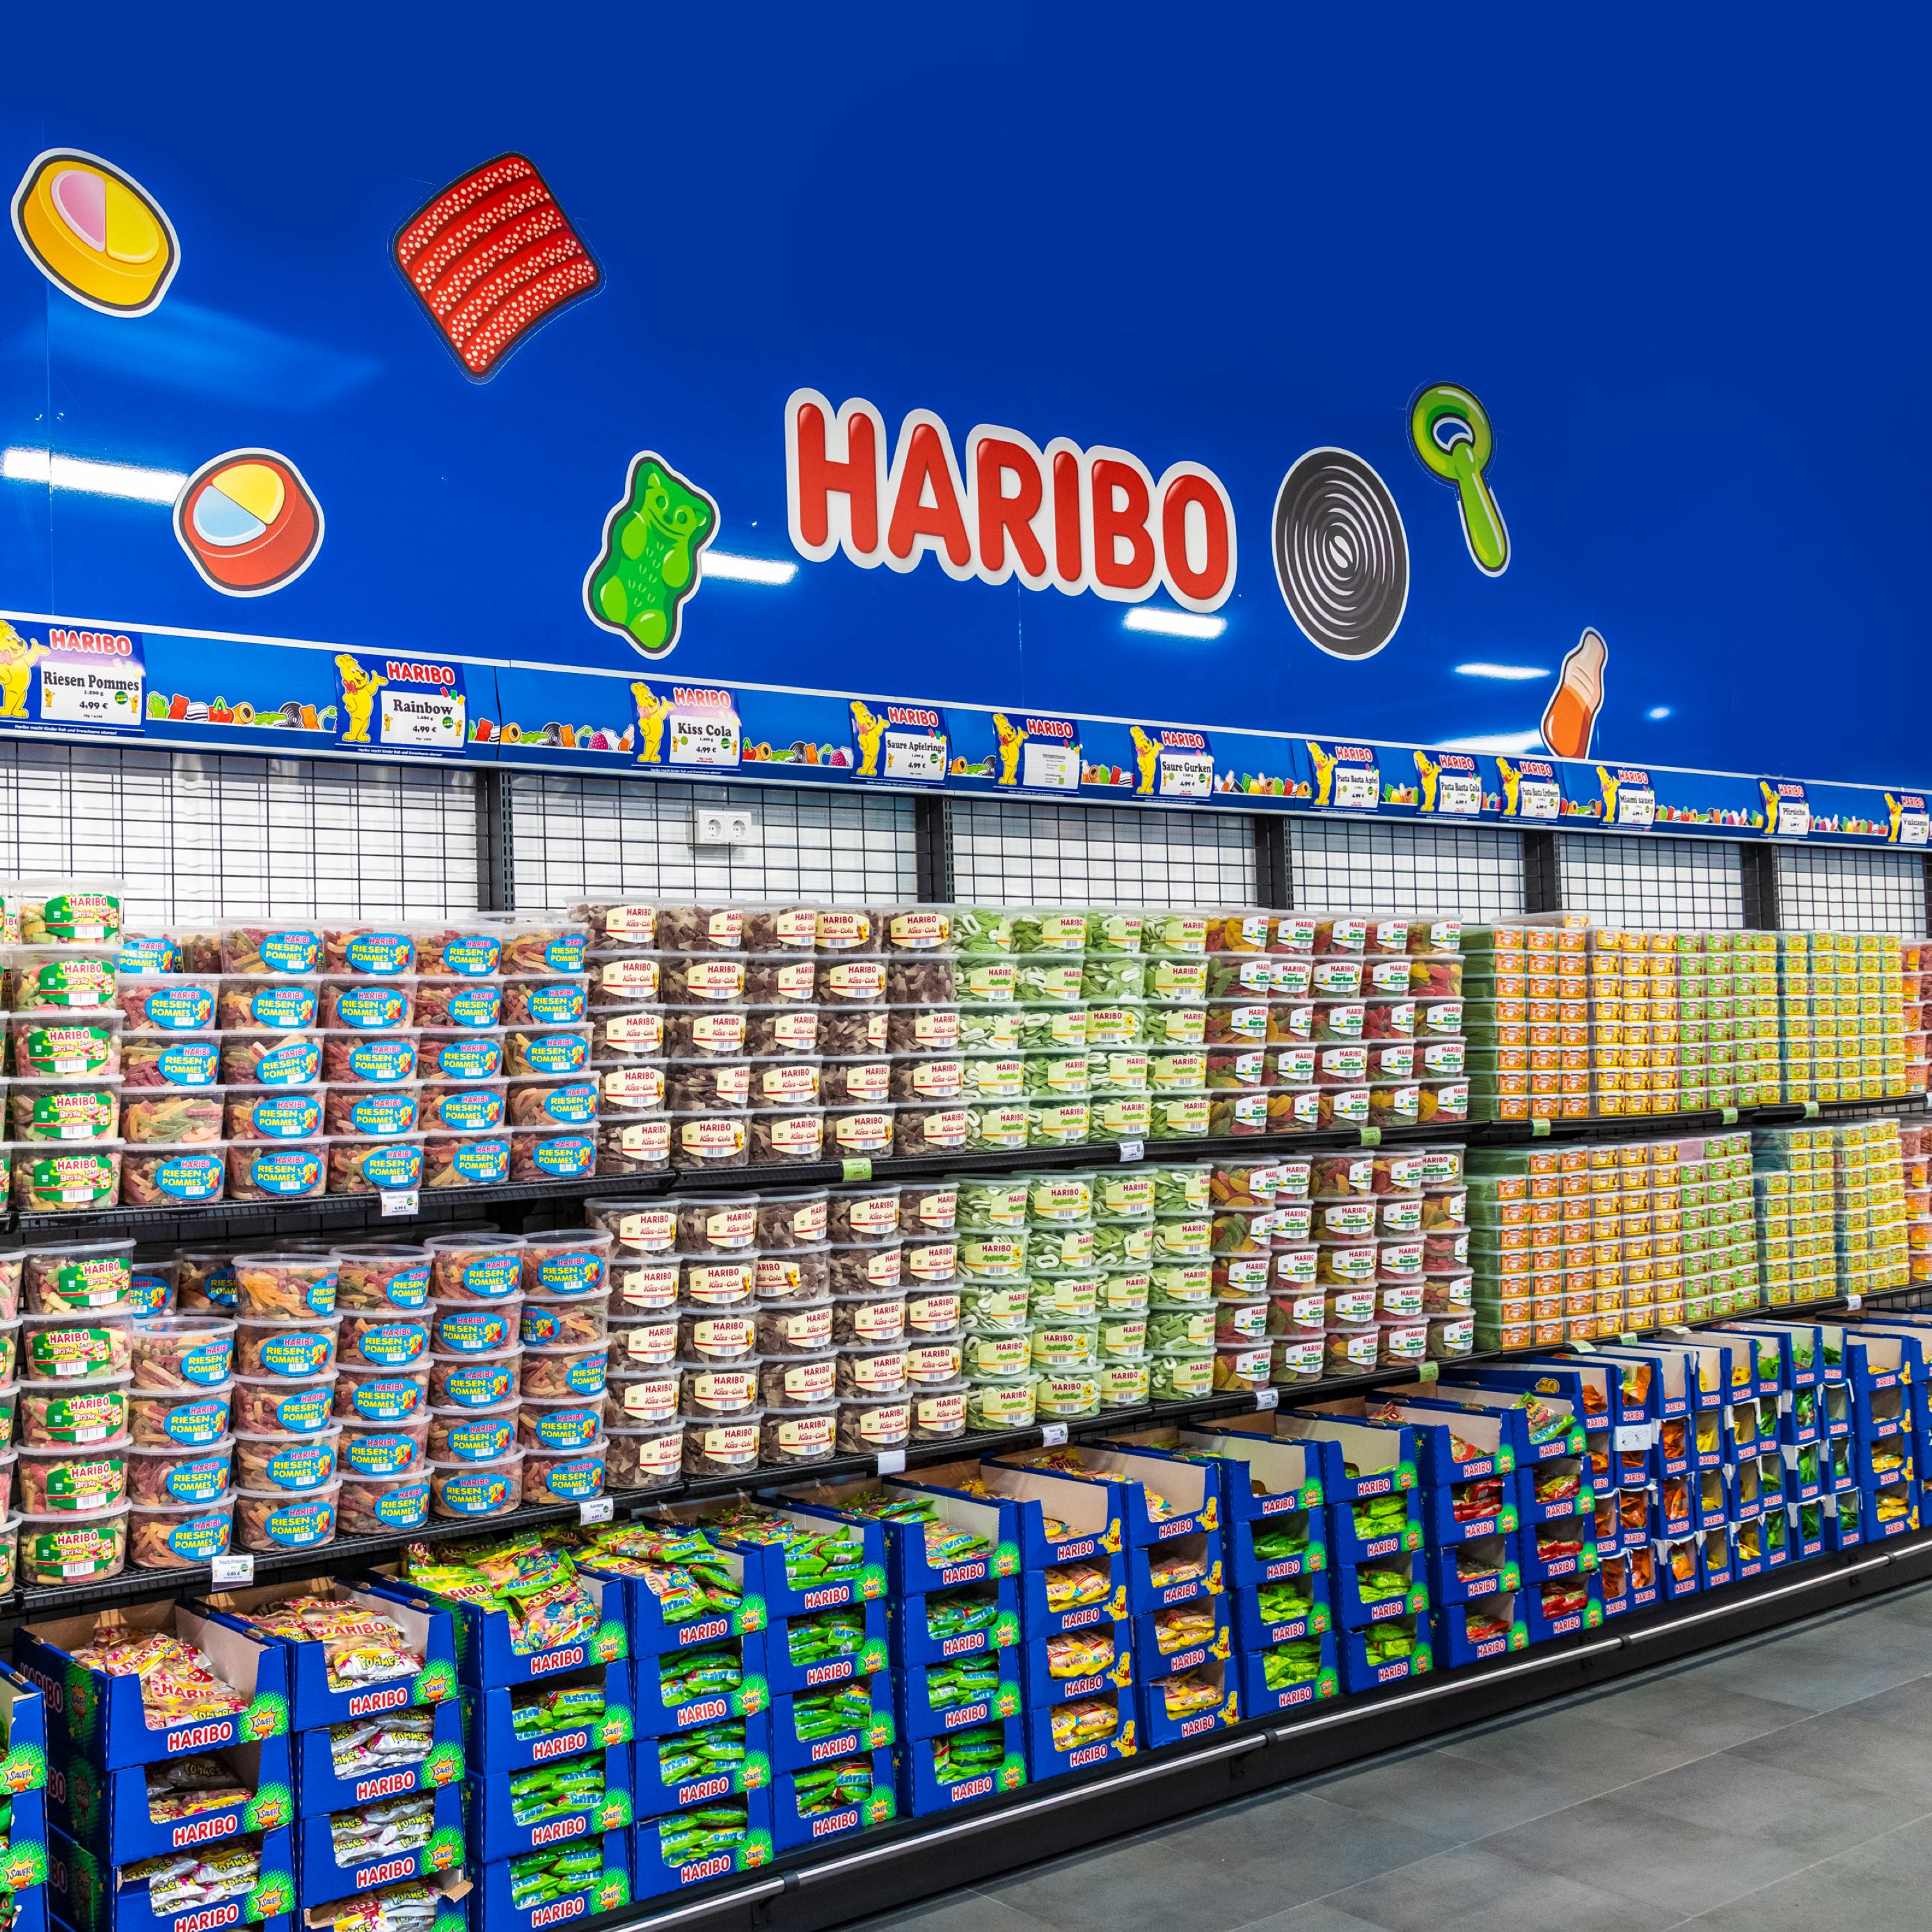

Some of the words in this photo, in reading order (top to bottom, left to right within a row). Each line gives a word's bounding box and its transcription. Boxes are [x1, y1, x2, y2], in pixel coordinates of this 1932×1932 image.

[797, 402, 1228, 600] HARIBO
[51, 630, 131, 655] HARIBO
[388, 663, 454, 684] HARIBO
[43, 671, 85, 687] Riesen
[88, 675, 139, 691] Pommes
[674, 688, 730, 708] HARIBO
[79, 701, 100, 710] 4,99
[393, 699, 453, 715] Rainbow
[889, 708, 937, 726] HARIBO
[678, 722, 702, 735] Kiss
[706, 724, 731, 737] Cola
[1027, 720, 1072, 737] HARIBO
[1162, 731, 1204, 747] HARIBO
[887, 740, 907, 749] Saure
[908, 742, 945, 754] Apfelringe
[1336, 747, 1372, 761] HARIBO
[1162, 761, 1183, 771] Saure
[1185, 763, 1211, 773] Gurken
[1440, 756, 1474, 770] HARIBO
[1520, 762, 1552, 777] HARIBO
[1365, 777, 1378, 785] Apfel
[1619, 770, 1648, 784] HARIBO
[1441, 782, 1455, 791] Pasta
[1778, 784, 1803, 796] HARIBO
[1620, 795, 1637, 803] Miami
[1901, 796, 1924, 808] HARIBO
[1903, 818, 1927, 826] Vulcano
[70, 896, 107, 907] HARIBO
[823, 926, 854, 935] Kiss-Cola
[352, 945, 389, 953] RIESEN
[351, 953, 388, 961] POMMES
[171, 990, 200, 999] HARIBO
[152, 999, 191, 1009] RIESEN
[151, 1008, 191, 1018] POMMES
[49, 1030, 90, 1041] HARIBO
[700, 1123, 731, 1132] HARIBO
[855, 1117, 882, 1125] HARIBO
[855, 1127, 882, 1136] Kiss-Cola
[701, 1134, 731, 1143] Kiss-Cola
[57, 1159, 97, 1170] HARIBO
[84, 1261, 120, 1275] HARIBO
[558, 1257, 586, 1266] HARIBO
[542, 1266, 578, 1274] RIESEN
[708, 1268, 739, 1278] HARIBO
[542, 1274, 578, 1282] POMMES
[708, 1280, 740, 1289] Kiss-Cola
[49, 1332, 89, 1345] HARIBO
[383, 1327, 411, 1337] HARIBO
[713, 1333, 743, 1342] Kiss-Cola
[365, 1337, 402, 1345] RIESEN
[365, 1345, 402, 1353] POMMES
[714, 1376, 745, 1384] HARIBO
[1797, 1373, 1814, 1384] HARIBO
[1877, 1376, 1896, 1387] HARIBO
[713, 1387, 744, 1396] Kiss-Cola
[1702, 1395, 1720, 1404] HARIBO
[1623, 1410, 1644, 1421] HARIBO
[1539, 1442, 1565, 1457] HARIBO
[1700, 1455, 1719, 1465] HARIBO
[1464, 1462, 1491, 1477] HARIBO
[461, 1478, 490, 1487] HARIBO
[1359, 1479, 1390, 1496] HARIBO
[447, 1494, 482, 1503] POMMES
[1160, 1520, 1191, 1539] HARIBO
[1885, 1521, 1904, 1534] HARIBO
[57, 1532, 98, 1545] HARIBO
[1059, 1542, 1094, 1560] HARIBO
[944, 1565, 984, 1584] HARIBO
[805, 1587, 849, 1608] HARIBO
[1606, 1600, 1626, 1614] HARIBO
[1554, 1617, 1580, 1633] HARIBO
[680, 1620, 727, 1645] HARIBO
[532, 1648, 583, 1674] HARIBO
[1379, 1664, 1408, 1681] HARIBO
[1066, 1677, 1102, 1696] HARIBO
[350, 1688, 407, 1716] HARIBO
[1280, 1688, 1311, 1707] HARIBO
[1182, 1716, 1214, 1736] HARIBO
[168, 1723, 230, 1751] HARIBO
[357, 1772, 414, 1800] HARIBO
[173, 1816, 237, 1846] HARIBO
[357, 1860, 414, 1887] HARIBO
[682, 1858, 730, 1882] HARIBO
[175, 1906, 237, 1932] HARIBO
[533, 1899, 584, 1927] HARIBO
